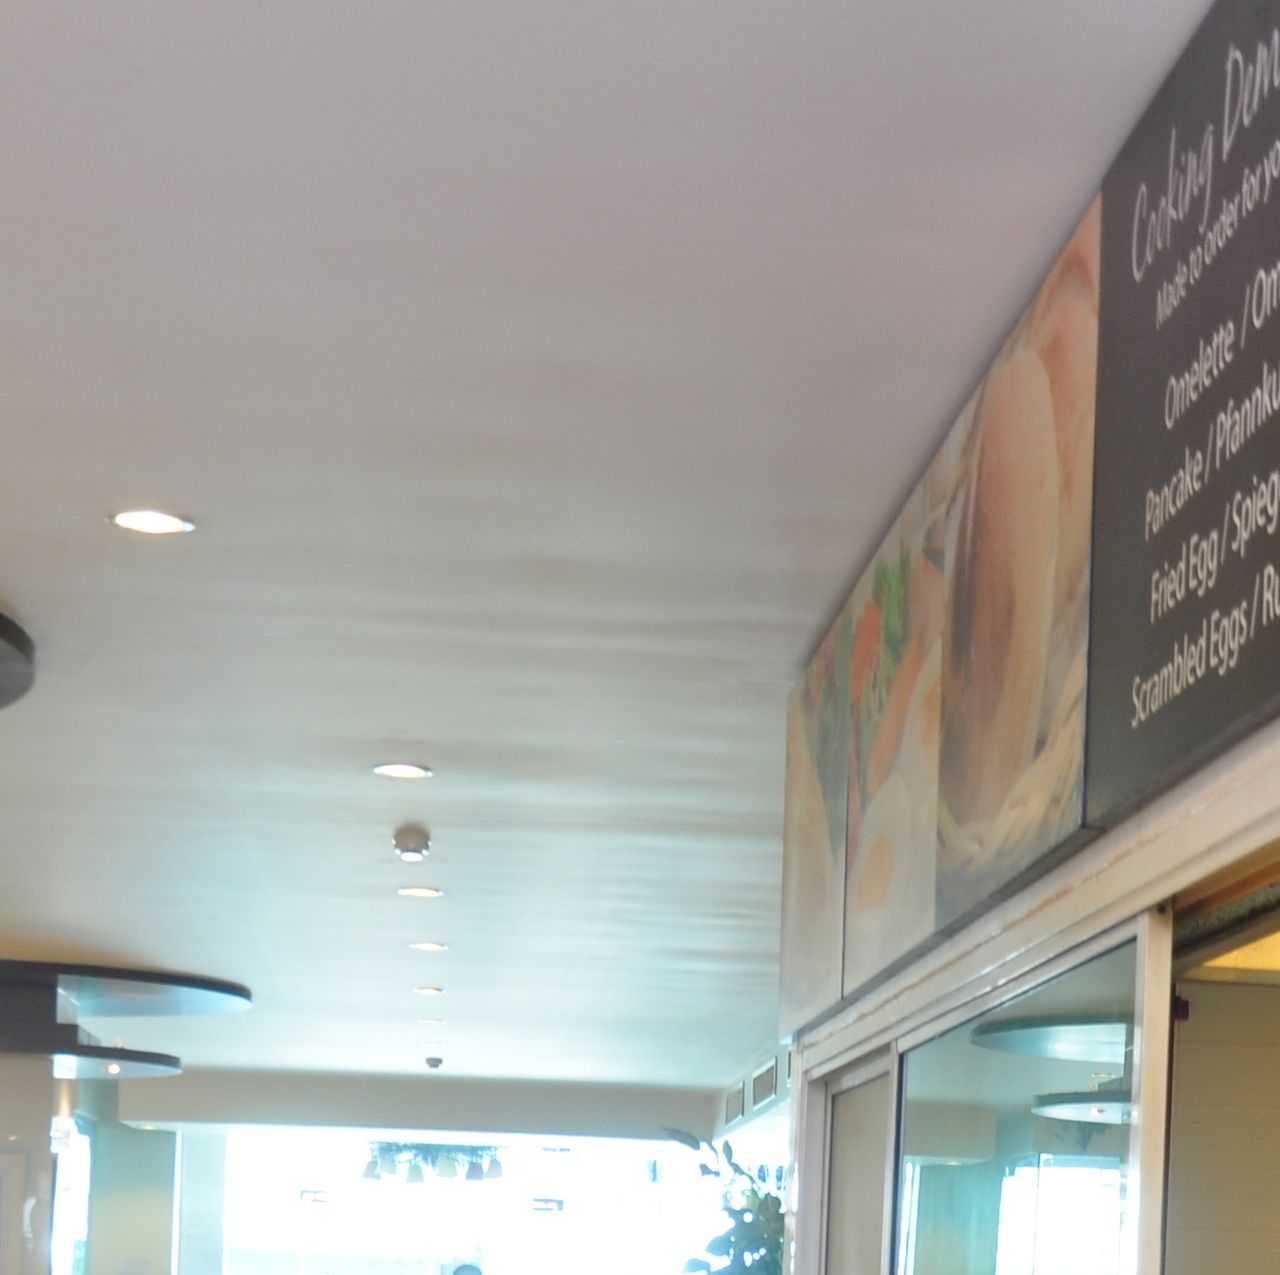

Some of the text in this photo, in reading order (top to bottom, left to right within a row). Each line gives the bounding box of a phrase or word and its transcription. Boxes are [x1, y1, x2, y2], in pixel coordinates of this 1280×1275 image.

[1132, 123, 1214, 282] Cooking
[1155, 258, 1188, 332] Made
[1188, 245, 1203, 286] to
[1204, 193, 1240, 266] order
[1241, 163, 1262, 218] for
[1165, 320, 1234, 430] Omelette
[1240, 283, 1250, 350] /
[1145, 445, 1203, 542] Pancake
[1204, 422, 1214, 484] /
[1150, 541, 1188, 626] Fried
[1189, 526, 1219, 598] Egg
[1221, 502, 1230, 566] /
[1130, 617, 1207, 730] Scrambled
[1209, 599, 1249, 678] Eggs
[1250, 573, 1260, 640] /
